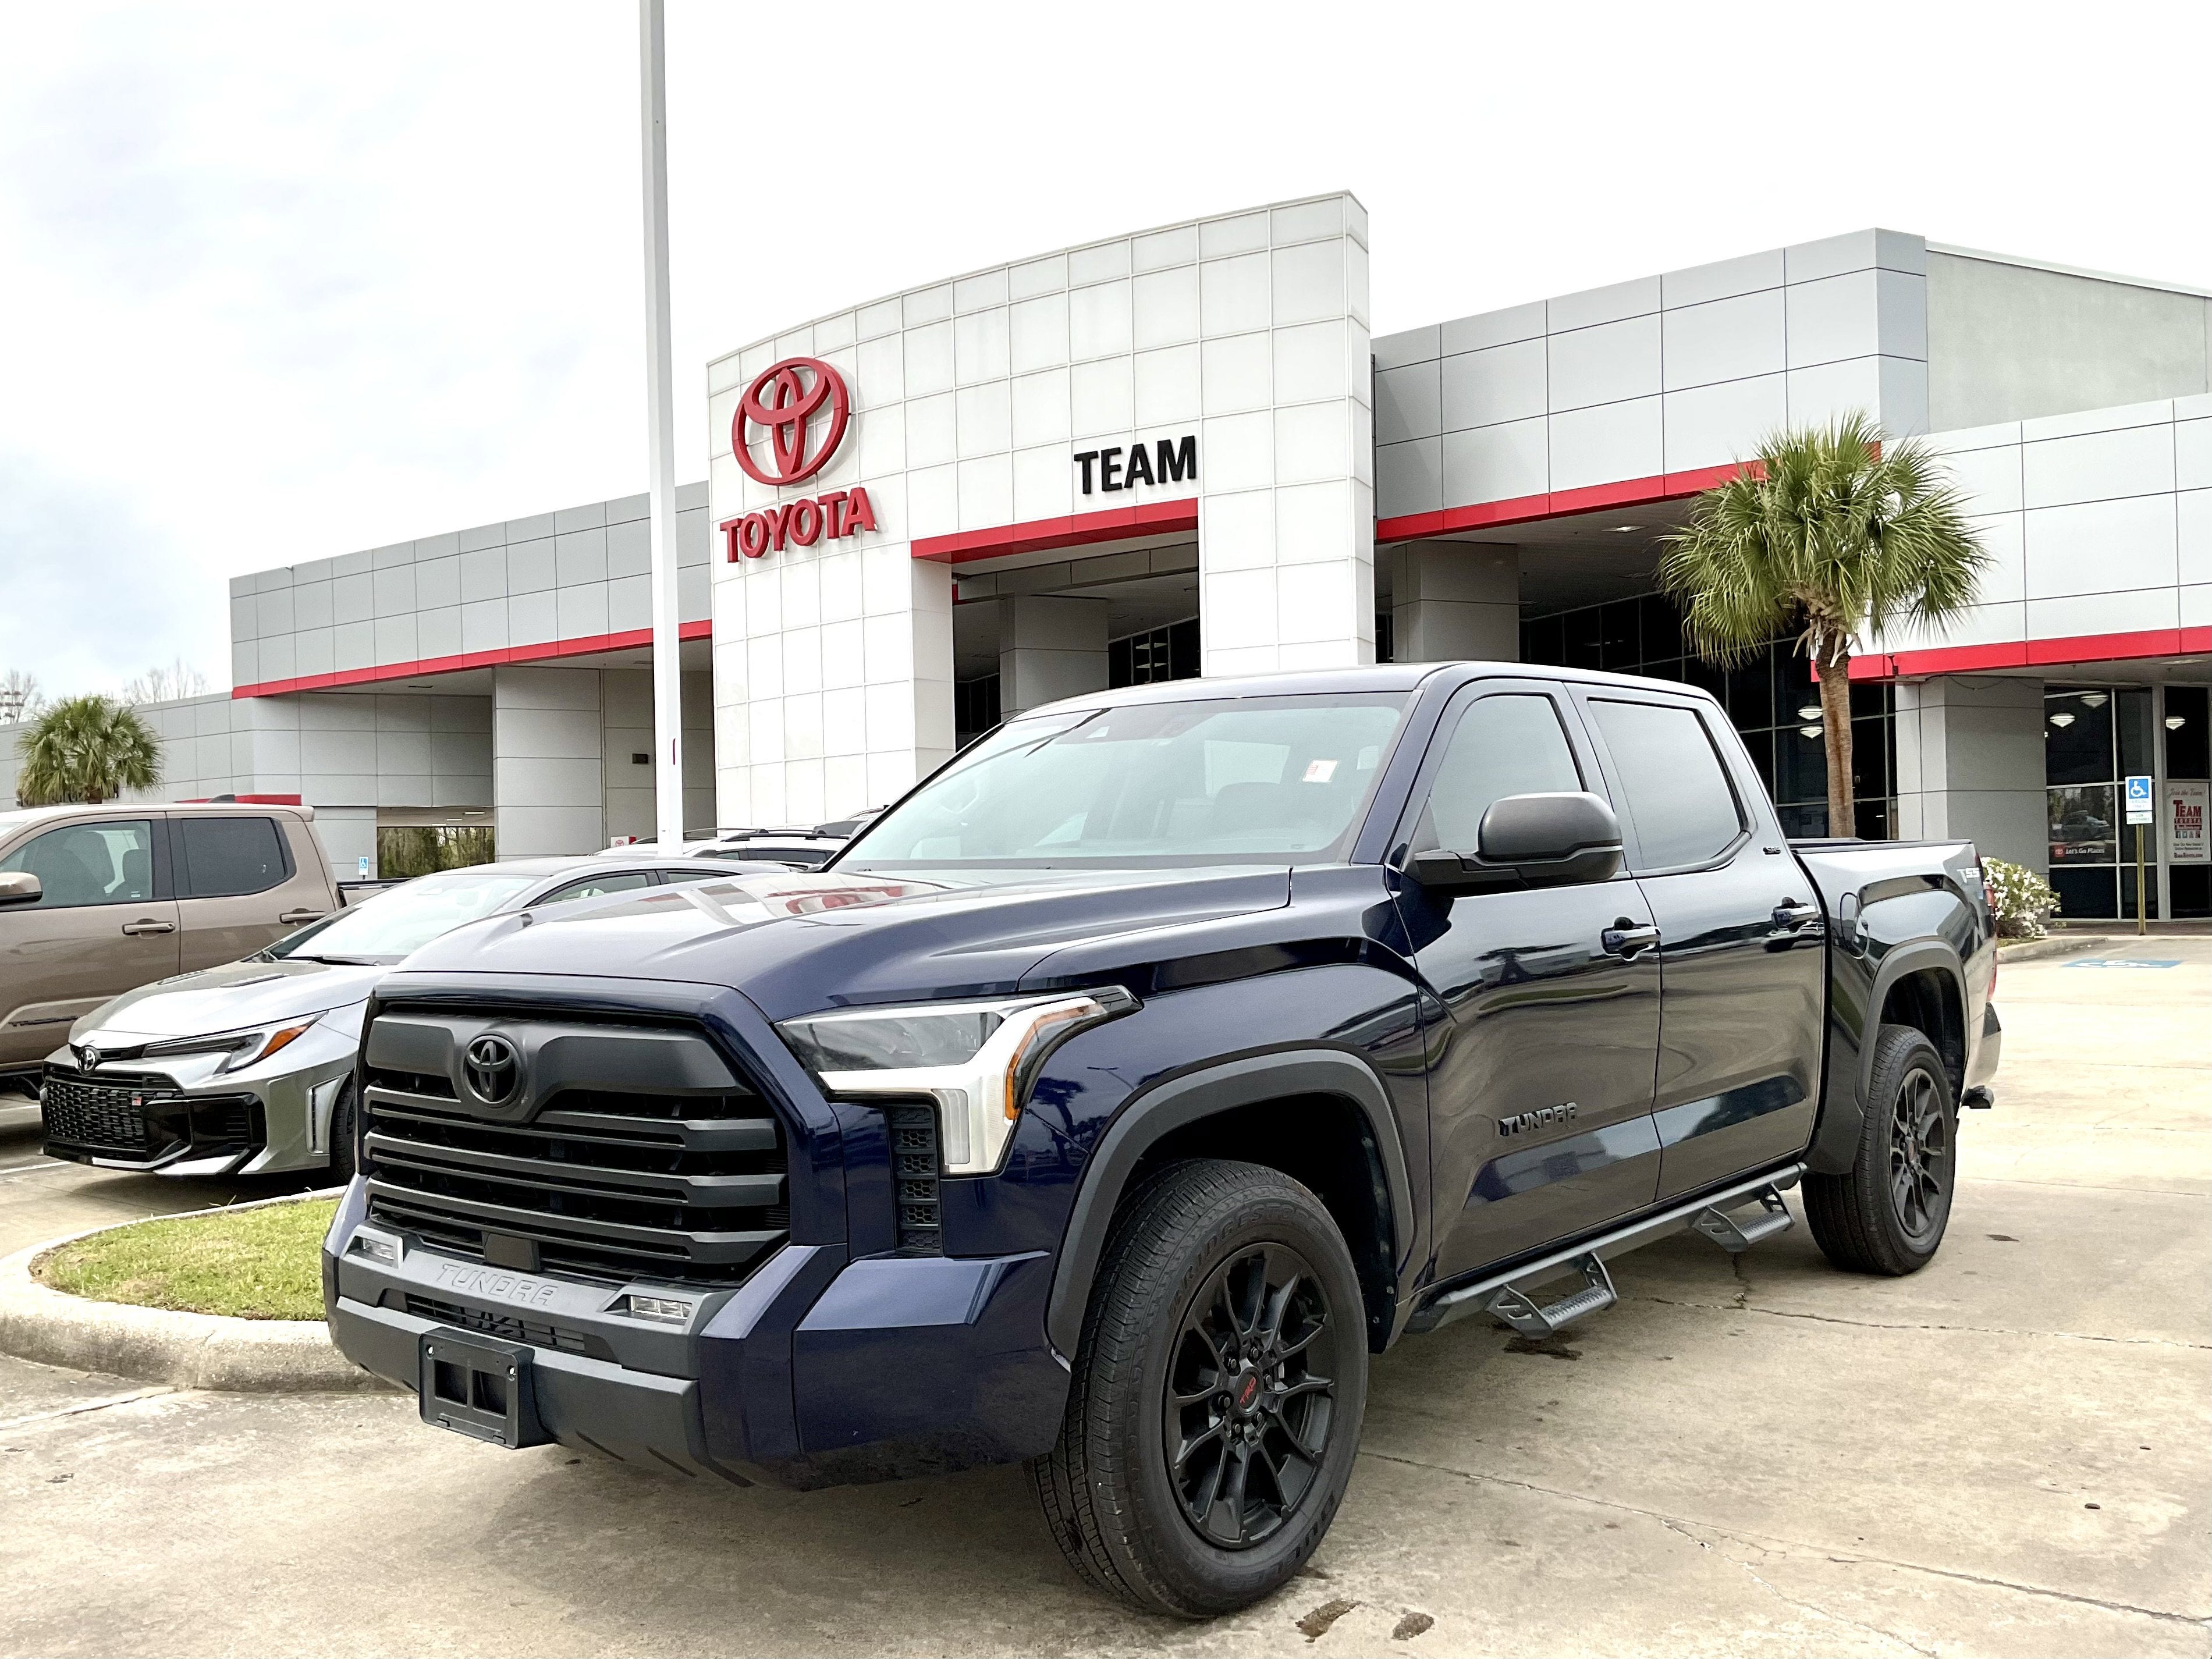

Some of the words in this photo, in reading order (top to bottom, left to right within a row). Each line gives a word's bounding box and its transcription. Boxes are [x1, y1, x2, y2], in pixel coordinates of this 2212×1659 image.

[1074, 435, 1197, 495] TEAM
[719, 487, 878, 563] TOYOTA
[2173, 800, 2202, 817] TEAM
[1499, 1102, 1578, 1136] TUNDRA
[437, 1263, 559, 1306] TUNDRA
[1239, 1376, 1257, 1404] TRD
